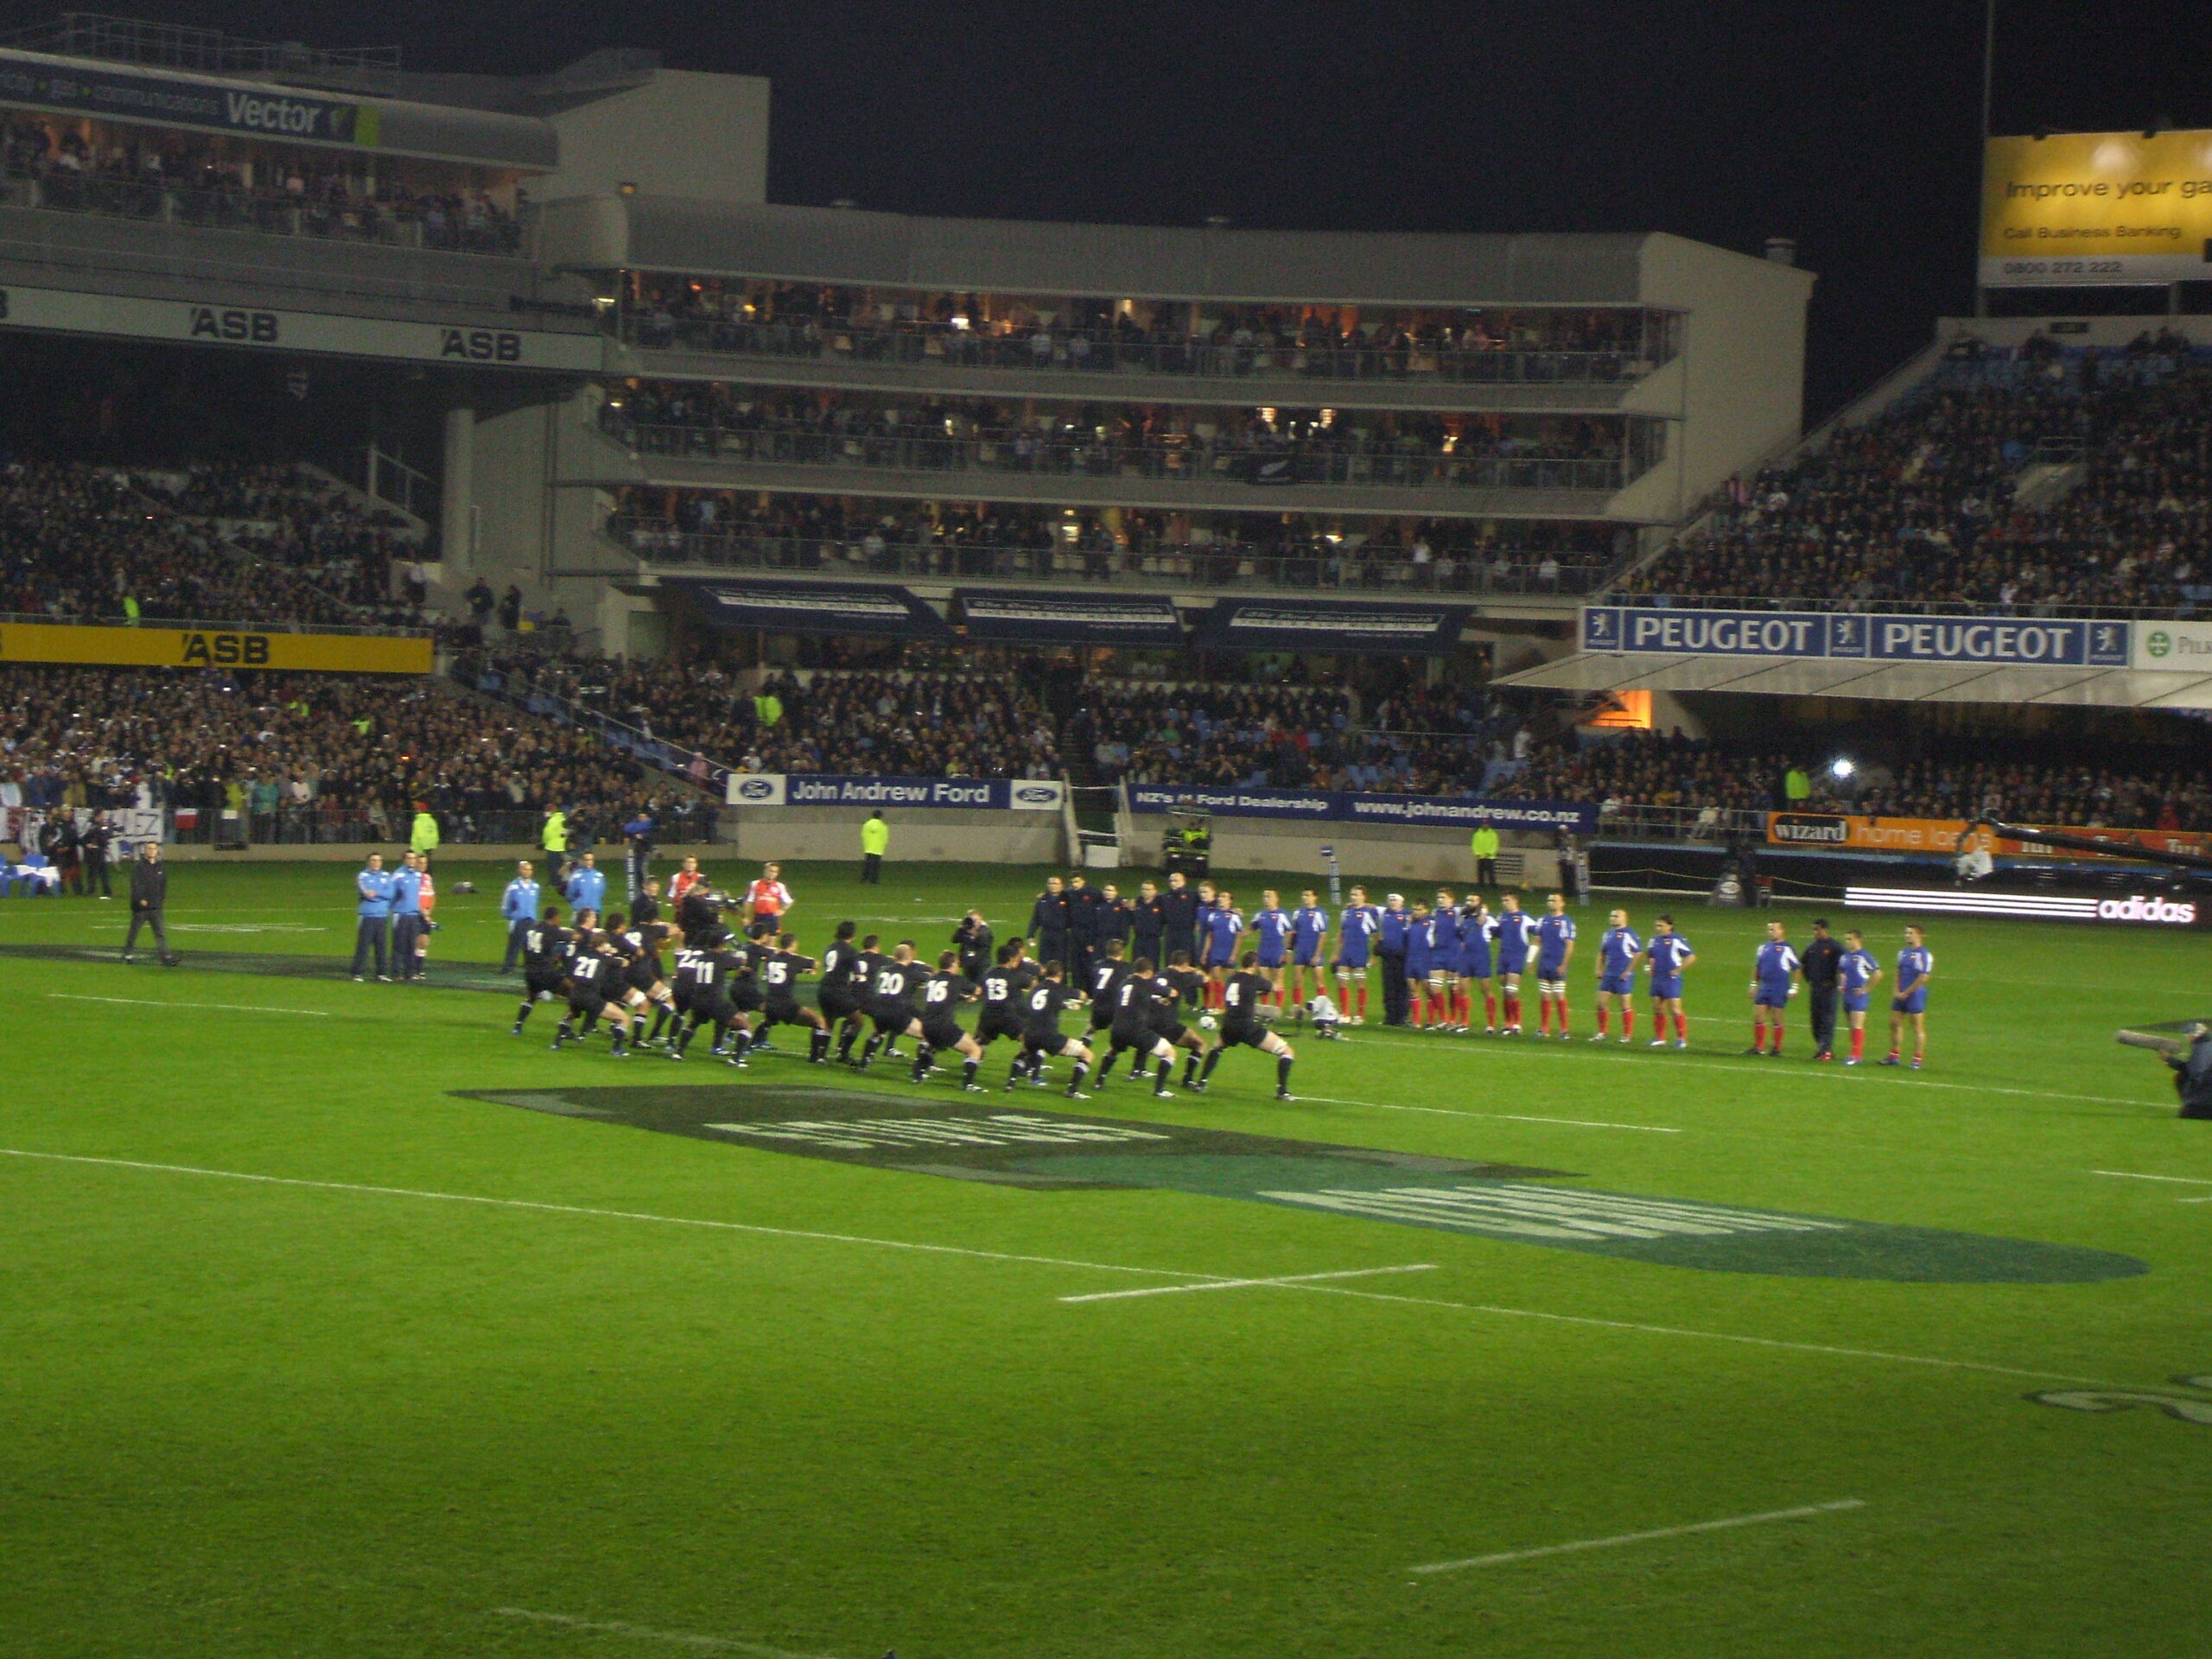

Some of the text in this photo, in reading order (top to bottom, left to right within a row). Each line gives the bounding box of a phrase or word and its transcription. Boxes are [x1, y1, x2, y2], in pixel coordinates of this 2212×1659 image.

[227, 92, 322, 132] Vector
[2006, 181, 2109, 201] Improve
[2117, 180, 2172, 200] your
[2004, 226, 2182, 239] Call Business Banking
[2052, 262, 2083, 273] 272
[2089, 261, 2123, 273] 222
[191, 307, 278, 342] ASB
[442, 329, 521, 361] ASB
[1634, 616, 1813, 651] PEUGEOT
[1883, 622, 2072, 658] PEUGEOT
[182, 633, 270, 664] ASB
[793, 781, 990, 803] John Andrew Ford
[1136, 791, 1173, 804] NZ's
[1197, 793, 1236, 806] Ford
[1239, 795, 1329, 811] Dealership
[1353, 801, 1581, 823] www.johnandrew.co.nz
[1774, 819, 1847, 842] wizard
[1858, 823, 1923, 845] home
[2099, 895, 2196, 923] adidas
[573, 956, 601, 978] 21
[696, 961, 715, 983] 11
[825, 950, 838, 972] 9
[879, 971, 905, 995] 20
[985, 977, 1008, 1001] 13
[1096, 967, 1115, 989] 7
[926, 979, 949, 1002] 16
[1031, 988, 1050, 1010] 6
[1120, 983, 1135, 1006] 1
[1224, 982, 1241, 1006] 4
